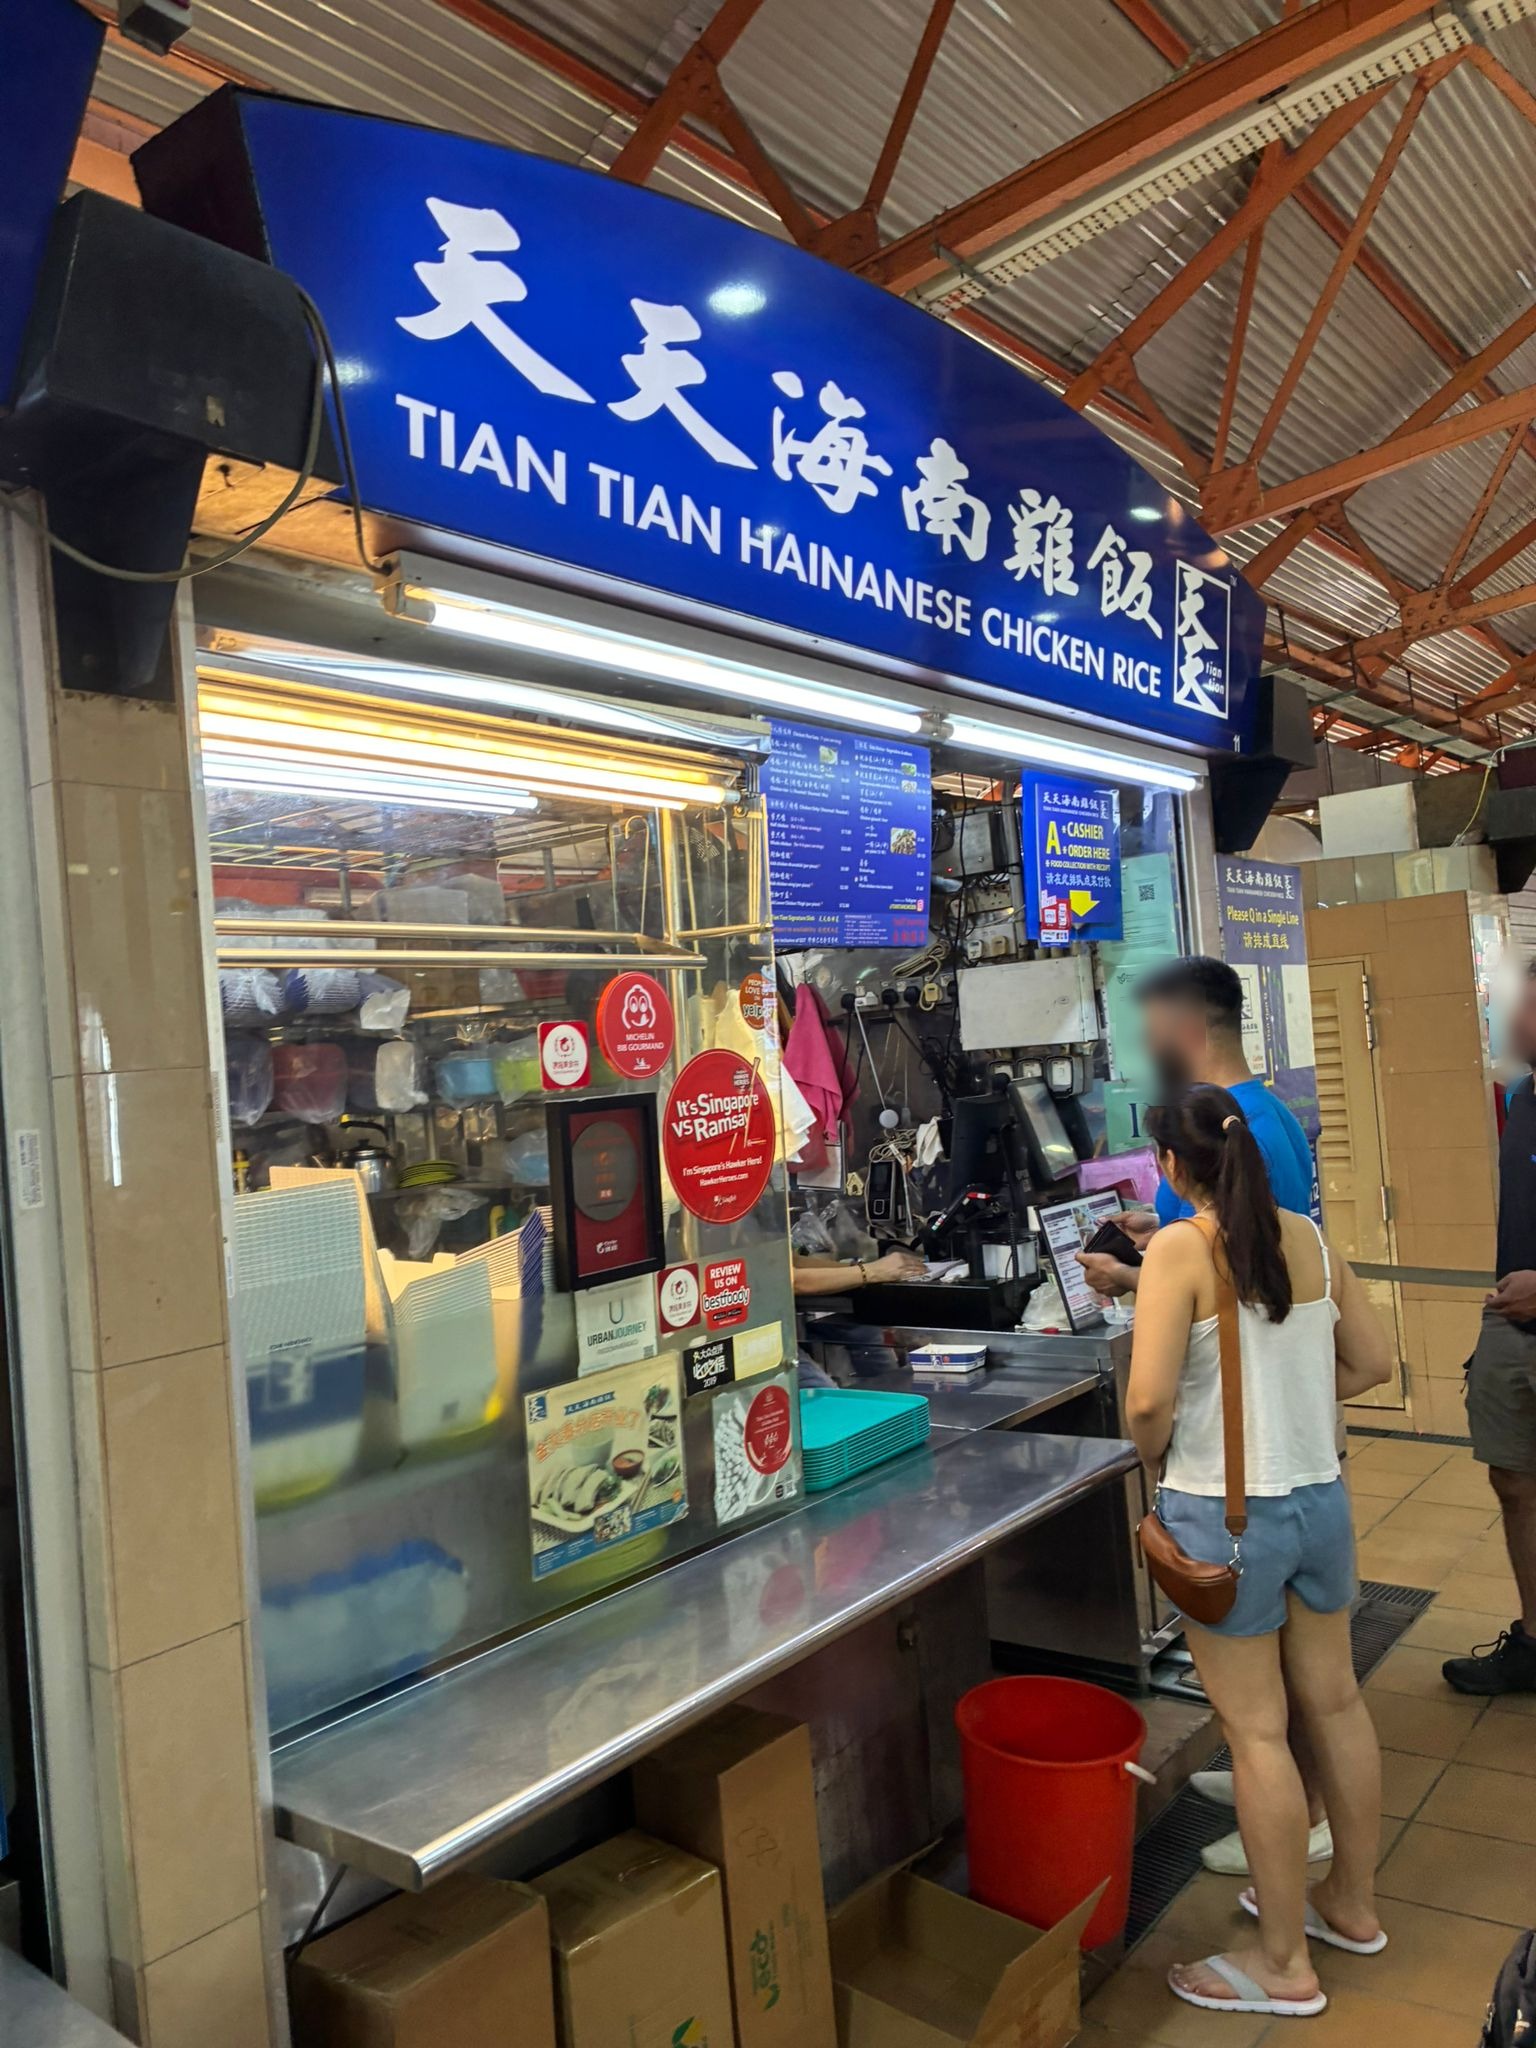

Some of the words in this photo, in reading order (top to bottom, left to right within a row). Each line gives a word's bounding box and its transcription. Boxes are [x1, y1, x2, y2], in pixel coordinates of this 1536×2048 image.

[394, 196, 1163, 640] 天天海南雞飯
[395, 393, 567, 506] TIAN
[588, 462, 721, 555] TIAN
[740, 516, 971, 637] HAINANESE
[981, 607, 1104, 681] CHICKEN
[1112, 652, 1162, 699] RICE
[1046, 820, 1061, 855] A
[1067, 821, 1104, 840] CASHIER
[1068, 844, 1092, 858] ORDER
[1093, 846, 1111, 860] HERE
[1227, 905, 1248, 922] Please
[1249, 907, 1256, 924] Q
[1255, 908, 1262, 922] in
[1263, 911, 1267, 923] a
[1267, 909, 1286, 928] Single
[1286, 911, 1299, 925] Line
[745, 986, 760, 995] LOVE
[626, 1033, 655, 1041] MICHELIN
[617, 1043, 627, 1052] BIB
[628, 1042, 664, 1052] GOURMAND
[676, 1099, 698, 1118] It's
[697, 1093, 759, 1116] Singapore
[693, 1112, 748, 1142] Ramsay
[693, 1161, 726, 1175] Singapore's
[725, 1157, 747, 1169] Hawker
[710, 1263, 741, 1279] REVIEW
[714, 1279, 724, 1289] US
[726, 1276, 737, 1287] ON
[703, 1286, 750, 1311] bestfoody
[587, 1320, 647, 1347] URBANJOURNEY
[703, 1376, 717, 1388] 2019
